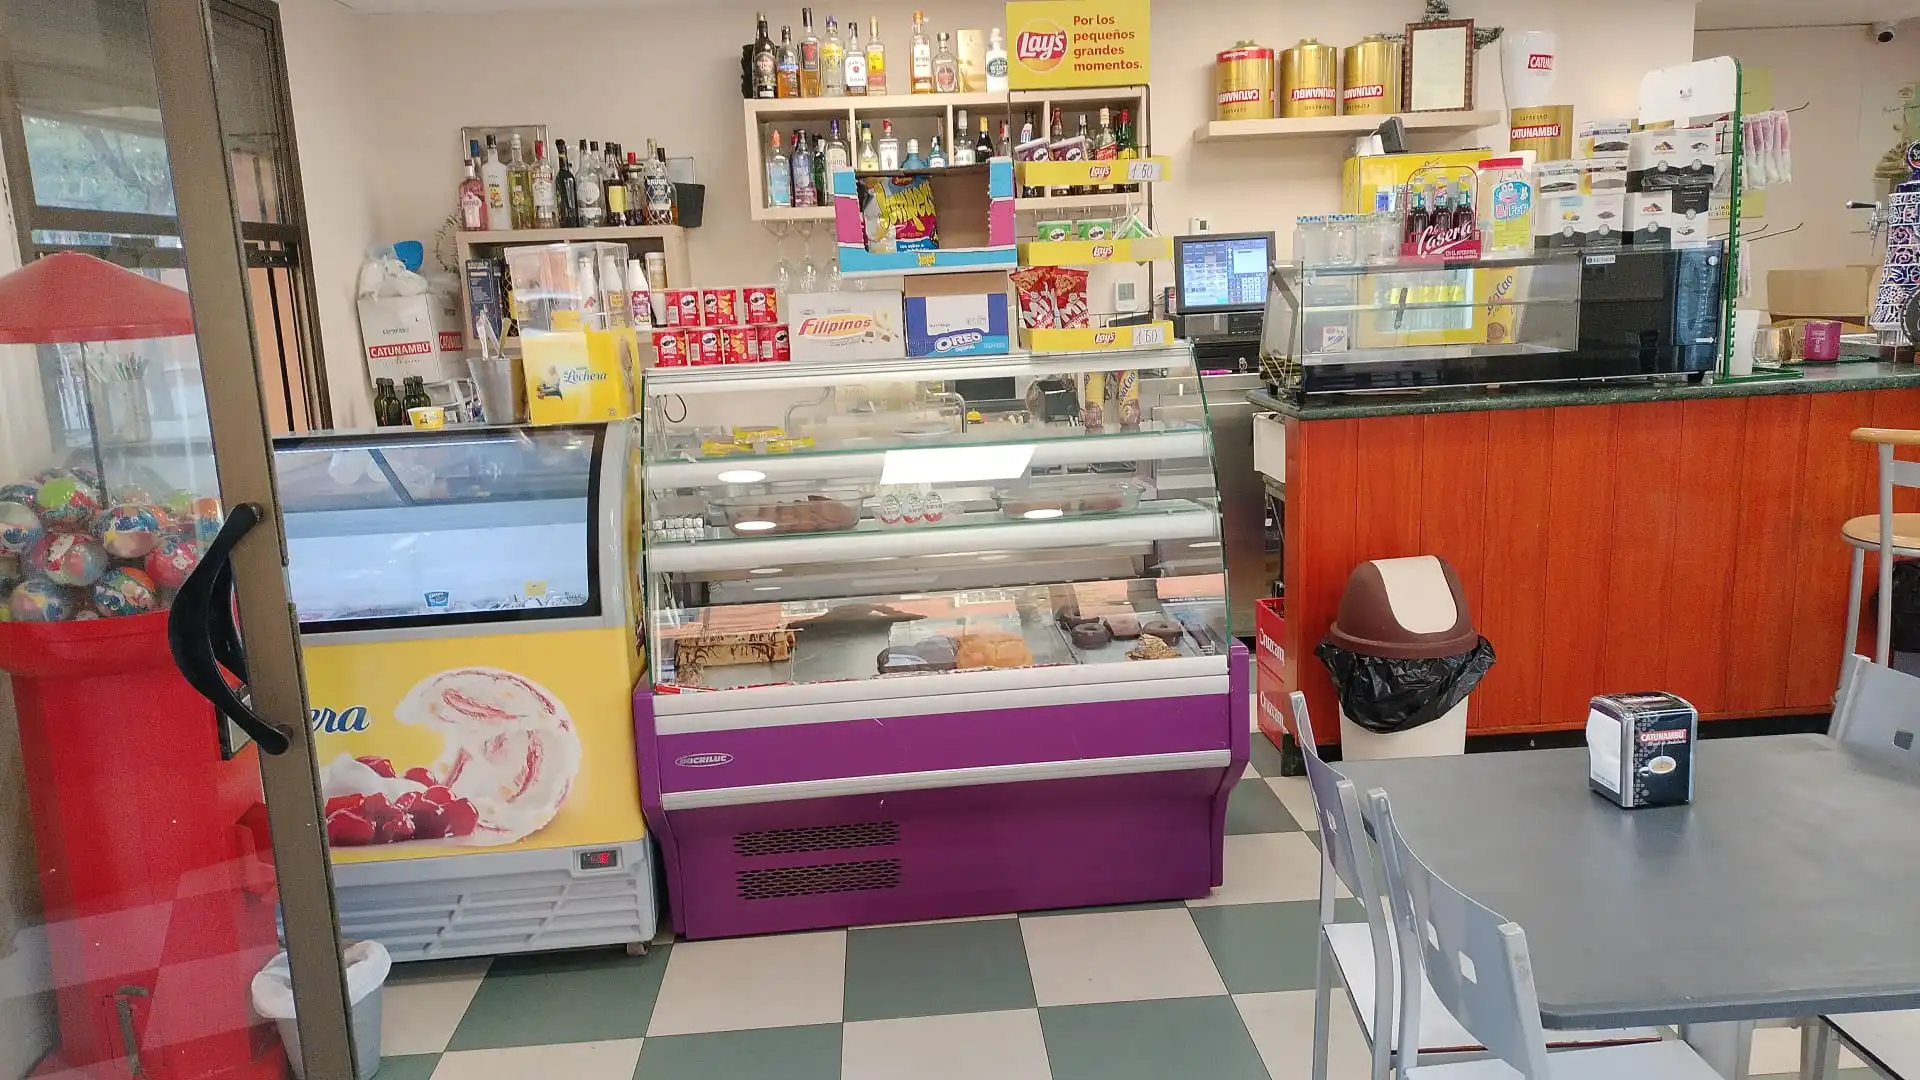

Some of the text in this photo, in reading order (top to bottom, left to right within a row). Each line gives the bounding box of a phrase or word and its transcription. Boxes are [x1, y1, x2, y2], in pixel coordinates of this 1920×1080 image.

[1073, 14, 1115, 26] Por los
[1073, 29, 1135, 44] pequeños
[1073, 45, 1125, 59] grandes
[1073, 60, 1143, 72] momentos.
[798, 318, 873, 336] Filipinos
[935, 332, 983, 353] OREO
